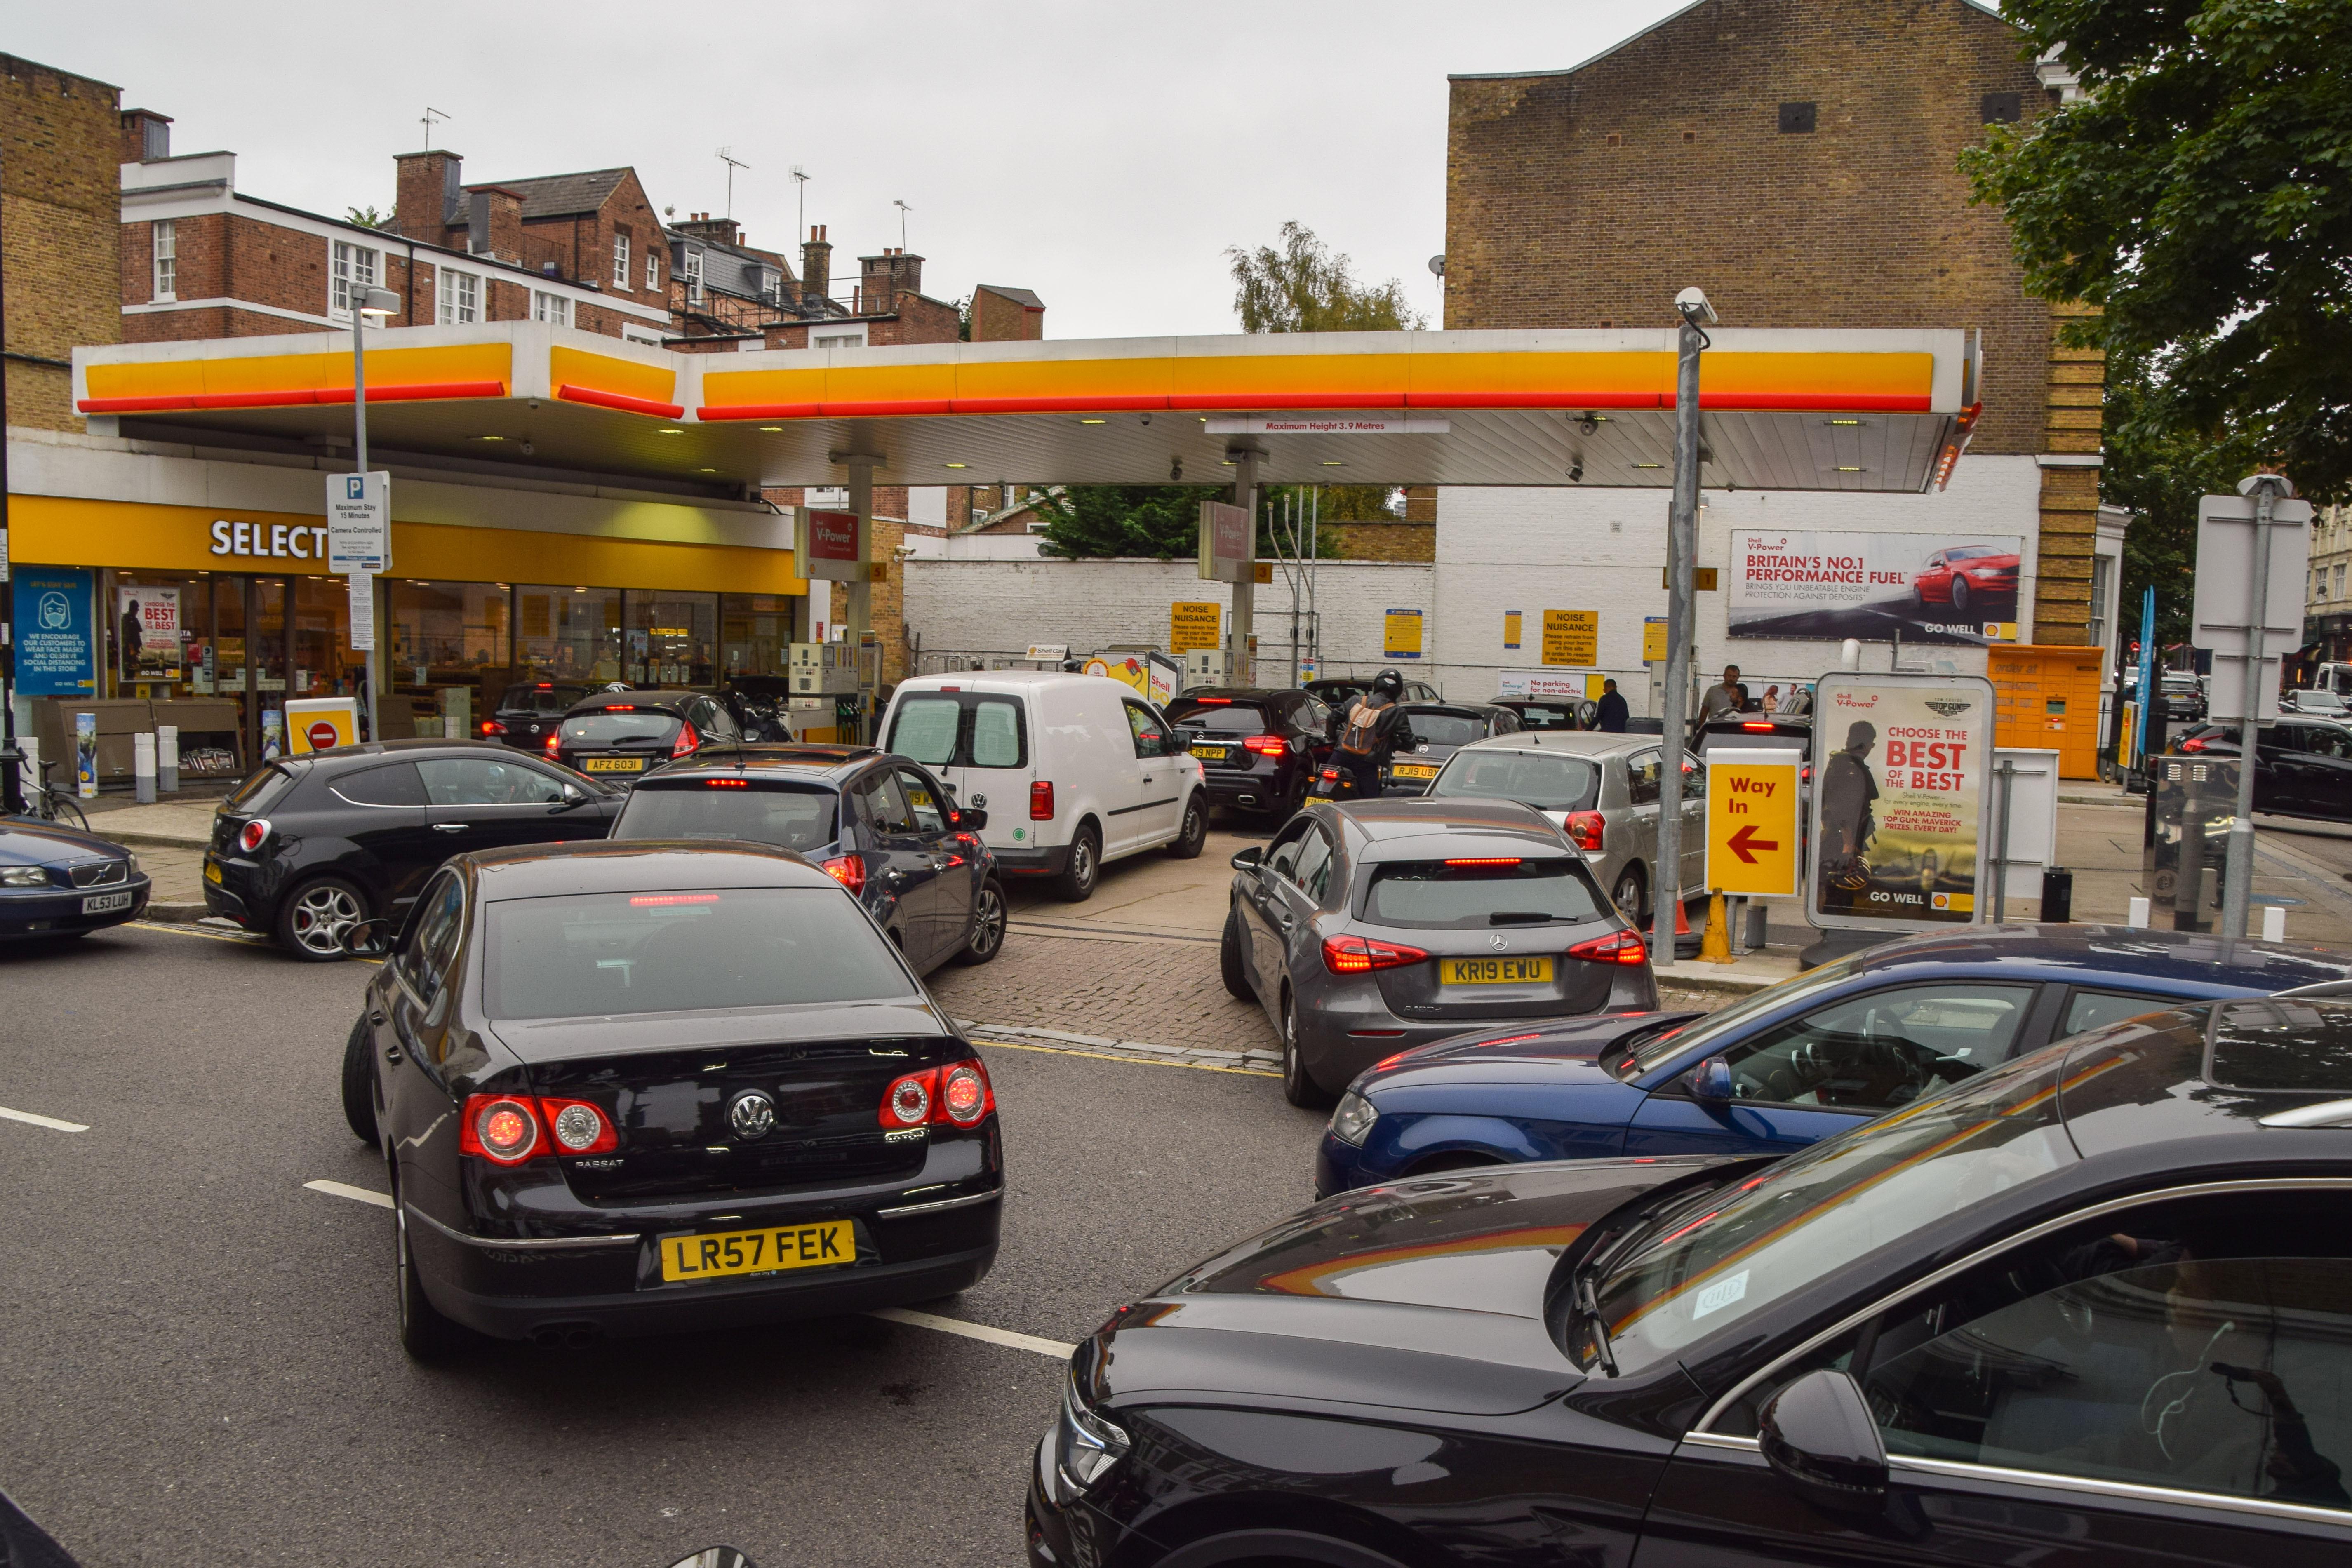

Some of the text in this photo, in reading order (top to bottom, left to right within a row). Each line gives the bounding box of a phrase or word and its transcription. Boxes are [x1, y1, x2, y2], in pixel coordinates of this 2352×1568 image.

[1309, 423, 1337, 431] Height
[350, 479, 361, 497] P
[211, 520, 328, 559] SELECT
[816, 527, 851, 543] V-Power
[1747, 555, 1863, 570] BRITAIN'S NO.1
[874, 567, 881, 577] 5
[1260, 567, 1267, 578] 3
[1746, 569, 1863, 583] PERFORMANCE
[1705, 574, 1710, 585] 1
[145, 607, 175, 621] BEST
[155, 622, 176, 630] BEST
[1547, 623, 1594, 632] NUISANCE
[1924, 623, 1976, 634] GO WELL
[1995, 663, 2037, 673] order at
[1151, 675, 1170, 693] Shell
[1150, 686, 1170, 705] GO
[1837, 700, 1875, 708] V-Power
[1888, 727, 1967, 740] CHOOSE THE
[1190, 748, 1222, 757] C19 NPP
[1886, 740, 1966, 770] BEST
[593, 760, 636, 769] AFZ 6031
[1399, 767, 1419, 776] RJ19
[1888, 769, 1903, 778] OF
[1729, 777, 1776, 797] Way
[1885, 771, 1965, 791] THE BEST
[1728, 798, 1748, 814] In
[1885, 823, 1912, 831] PRIZES,
[1922, 818, 1962, 827] MAVERICK
[87, 893, 129, 911] KL53 LUH
[1870, 891, 1924, 905] GO WELL
[1455, 960, 1540, 980] KR19 EWU
[576, 1159, 624, 1168] PASSAT
[677, 1227, 840, 1273] LR57 FEK
